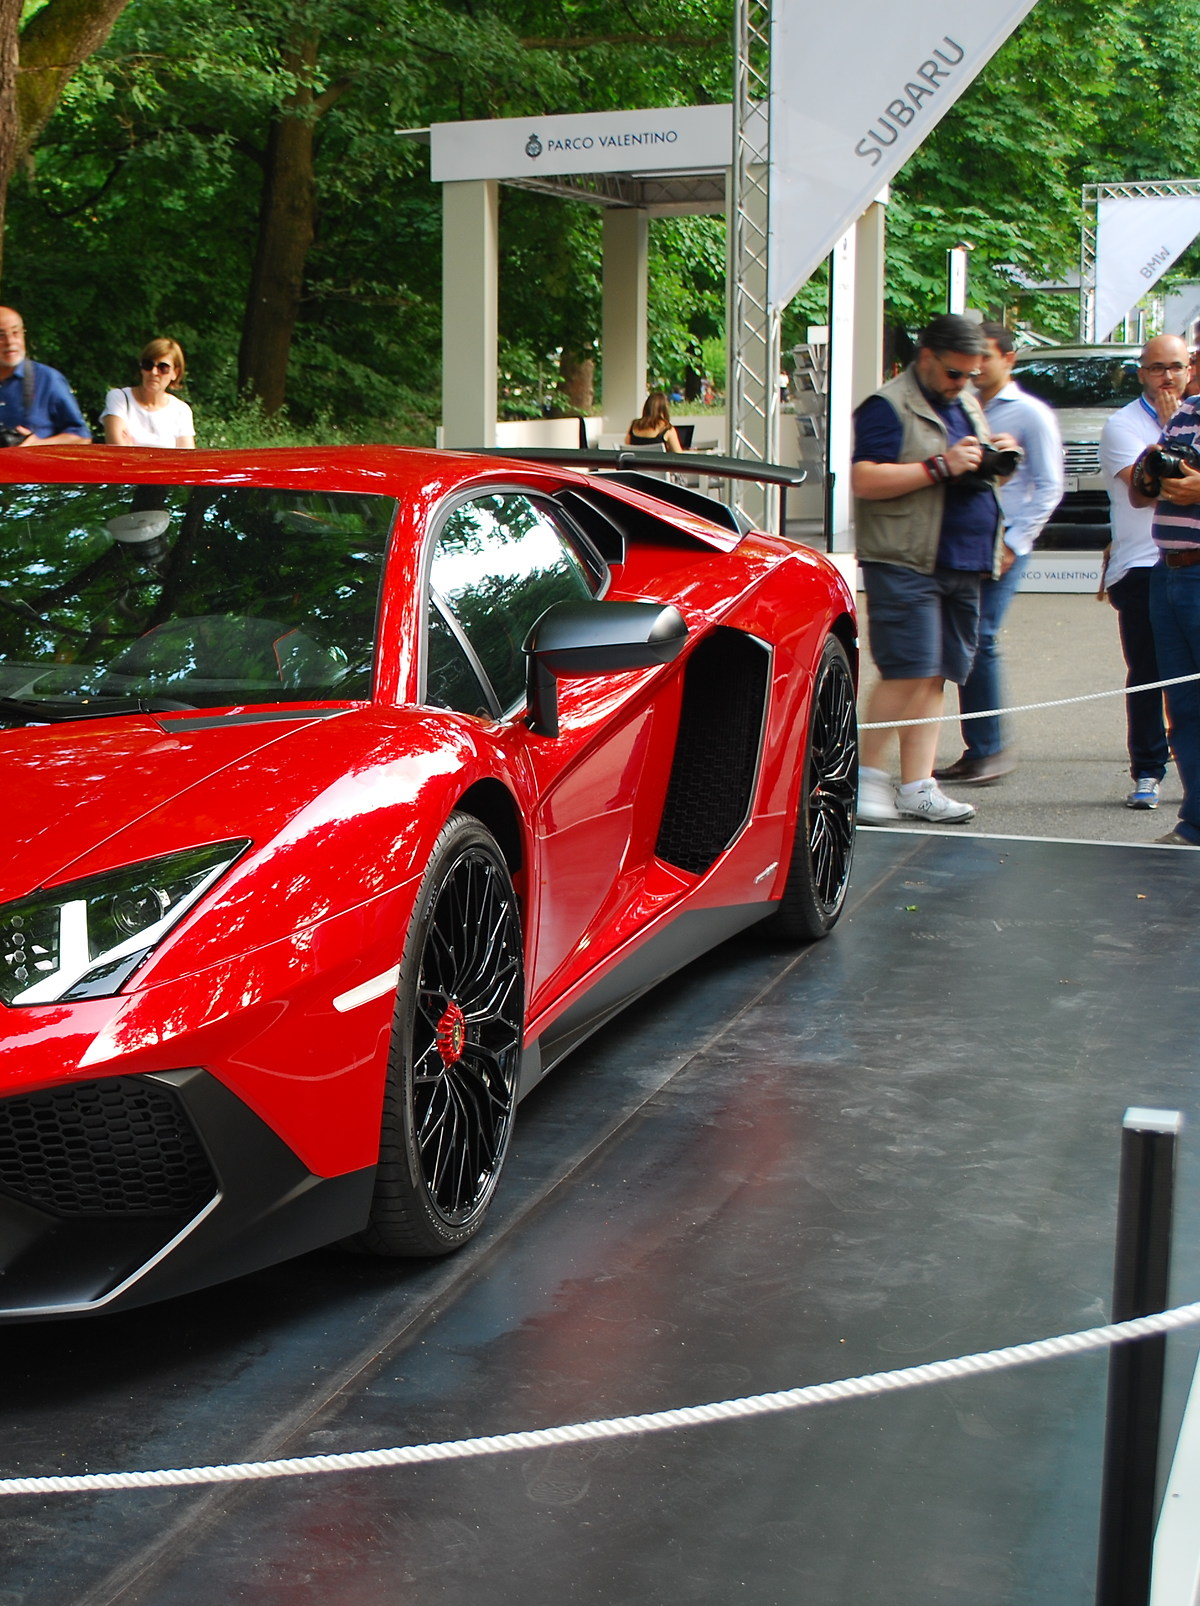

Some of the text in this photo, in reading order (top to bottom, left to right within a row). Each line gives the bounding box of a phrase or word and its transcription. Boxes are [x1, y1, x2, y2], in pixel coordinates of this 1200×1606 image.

[854, 36, 964, 167] SUBARU
[548, 130, 678, 151] PARCO VALENTINO
[1140, 246, 1170, 279] BMW
[1045, 571, 1098, 580] VALENTINO
